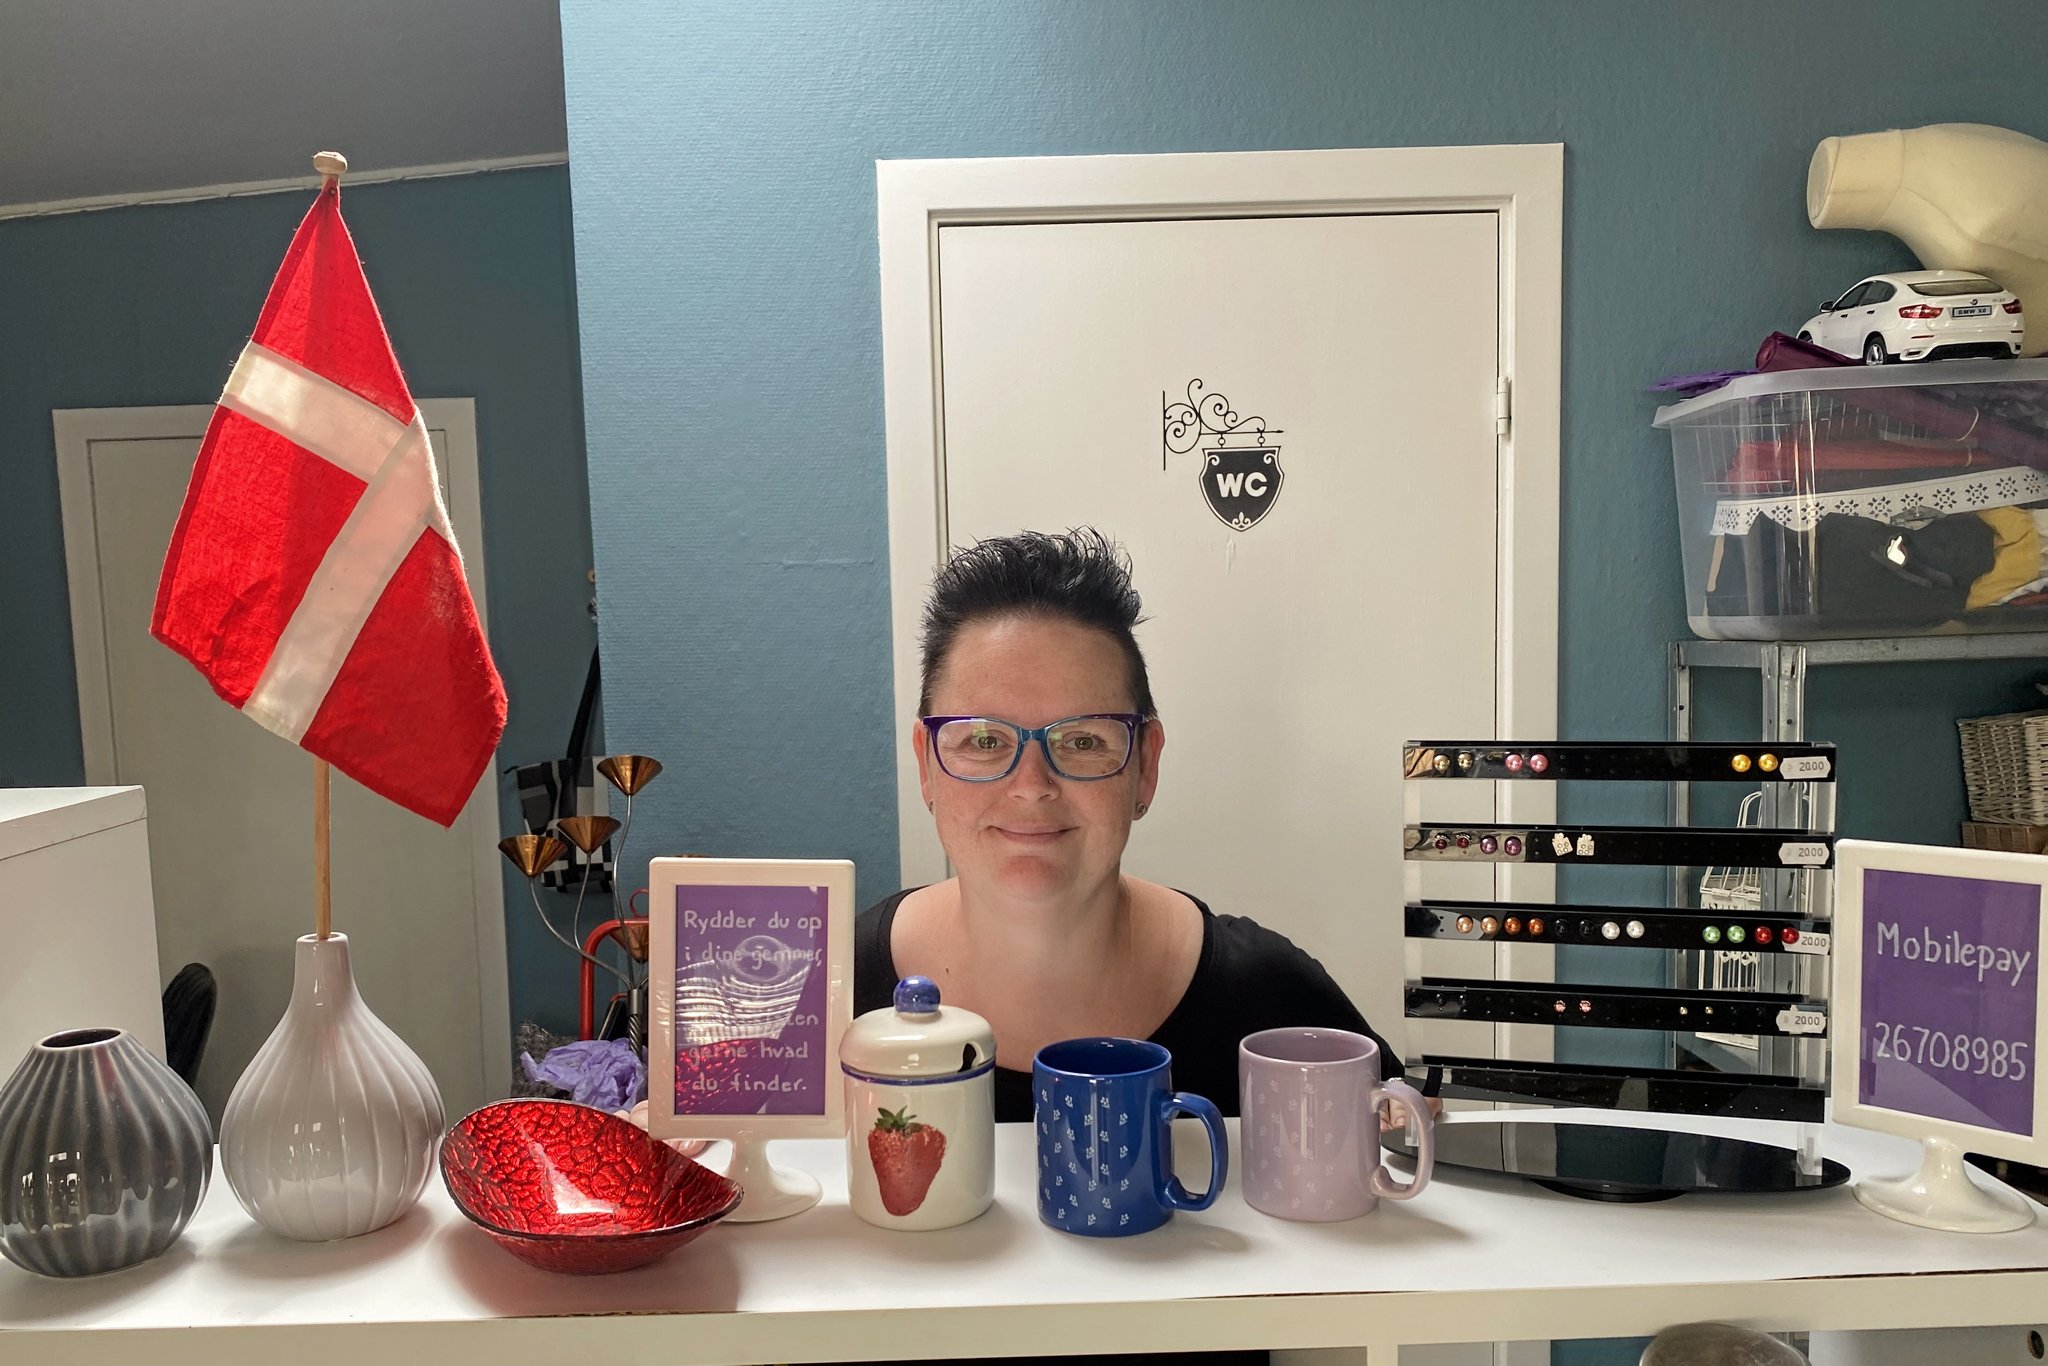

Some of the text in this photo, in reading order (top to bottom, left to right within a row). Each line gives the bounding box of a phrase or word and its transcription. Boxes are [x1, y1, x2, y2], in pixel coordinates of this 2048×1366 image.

[1216, 471, 1268, 498] WC
[684, 909, 823, 938] Rydder du op
[684, 946, 691, 962] i
[702, 941, 743, 962] dine
[1876, 920, 2032, 987] Mobilepay
[760, 1040, 809, 1059] hvad
[1875, 1021, 2029, 1082] 26708985
[691, 1073, 719, 1091] du
